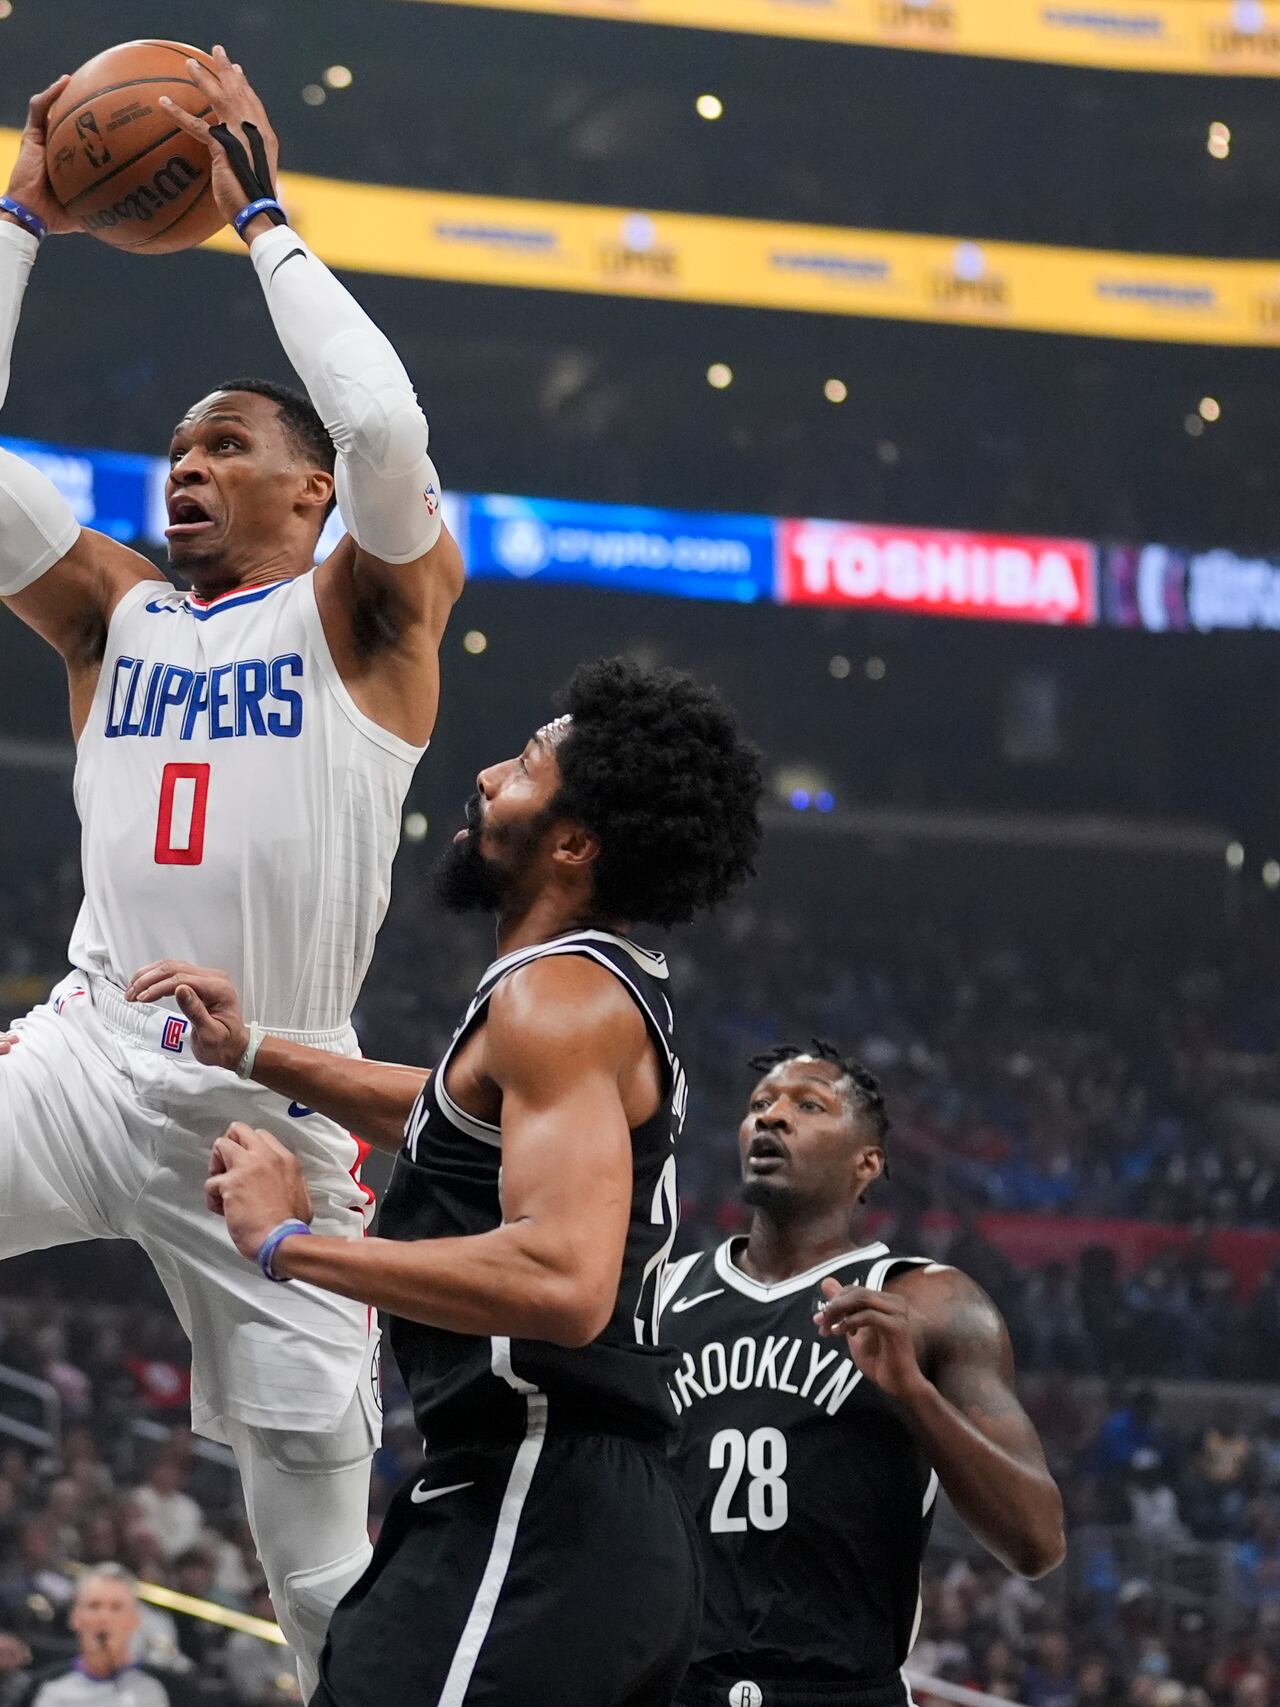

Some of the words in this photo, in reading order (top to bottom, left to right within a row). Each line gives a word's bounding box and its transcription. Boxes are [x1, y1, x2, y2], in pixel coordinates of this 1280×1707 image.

[82, 155, 202, 229] Wilson
[550, 527, 752, 575] crypto.com
[795, 533, 1079, 613] TOSHIBA
[104, 653, 304, 741] CLIPPERS
[154, 762, 211, 866] 0
[708, 1426, 789, 1534] 28
